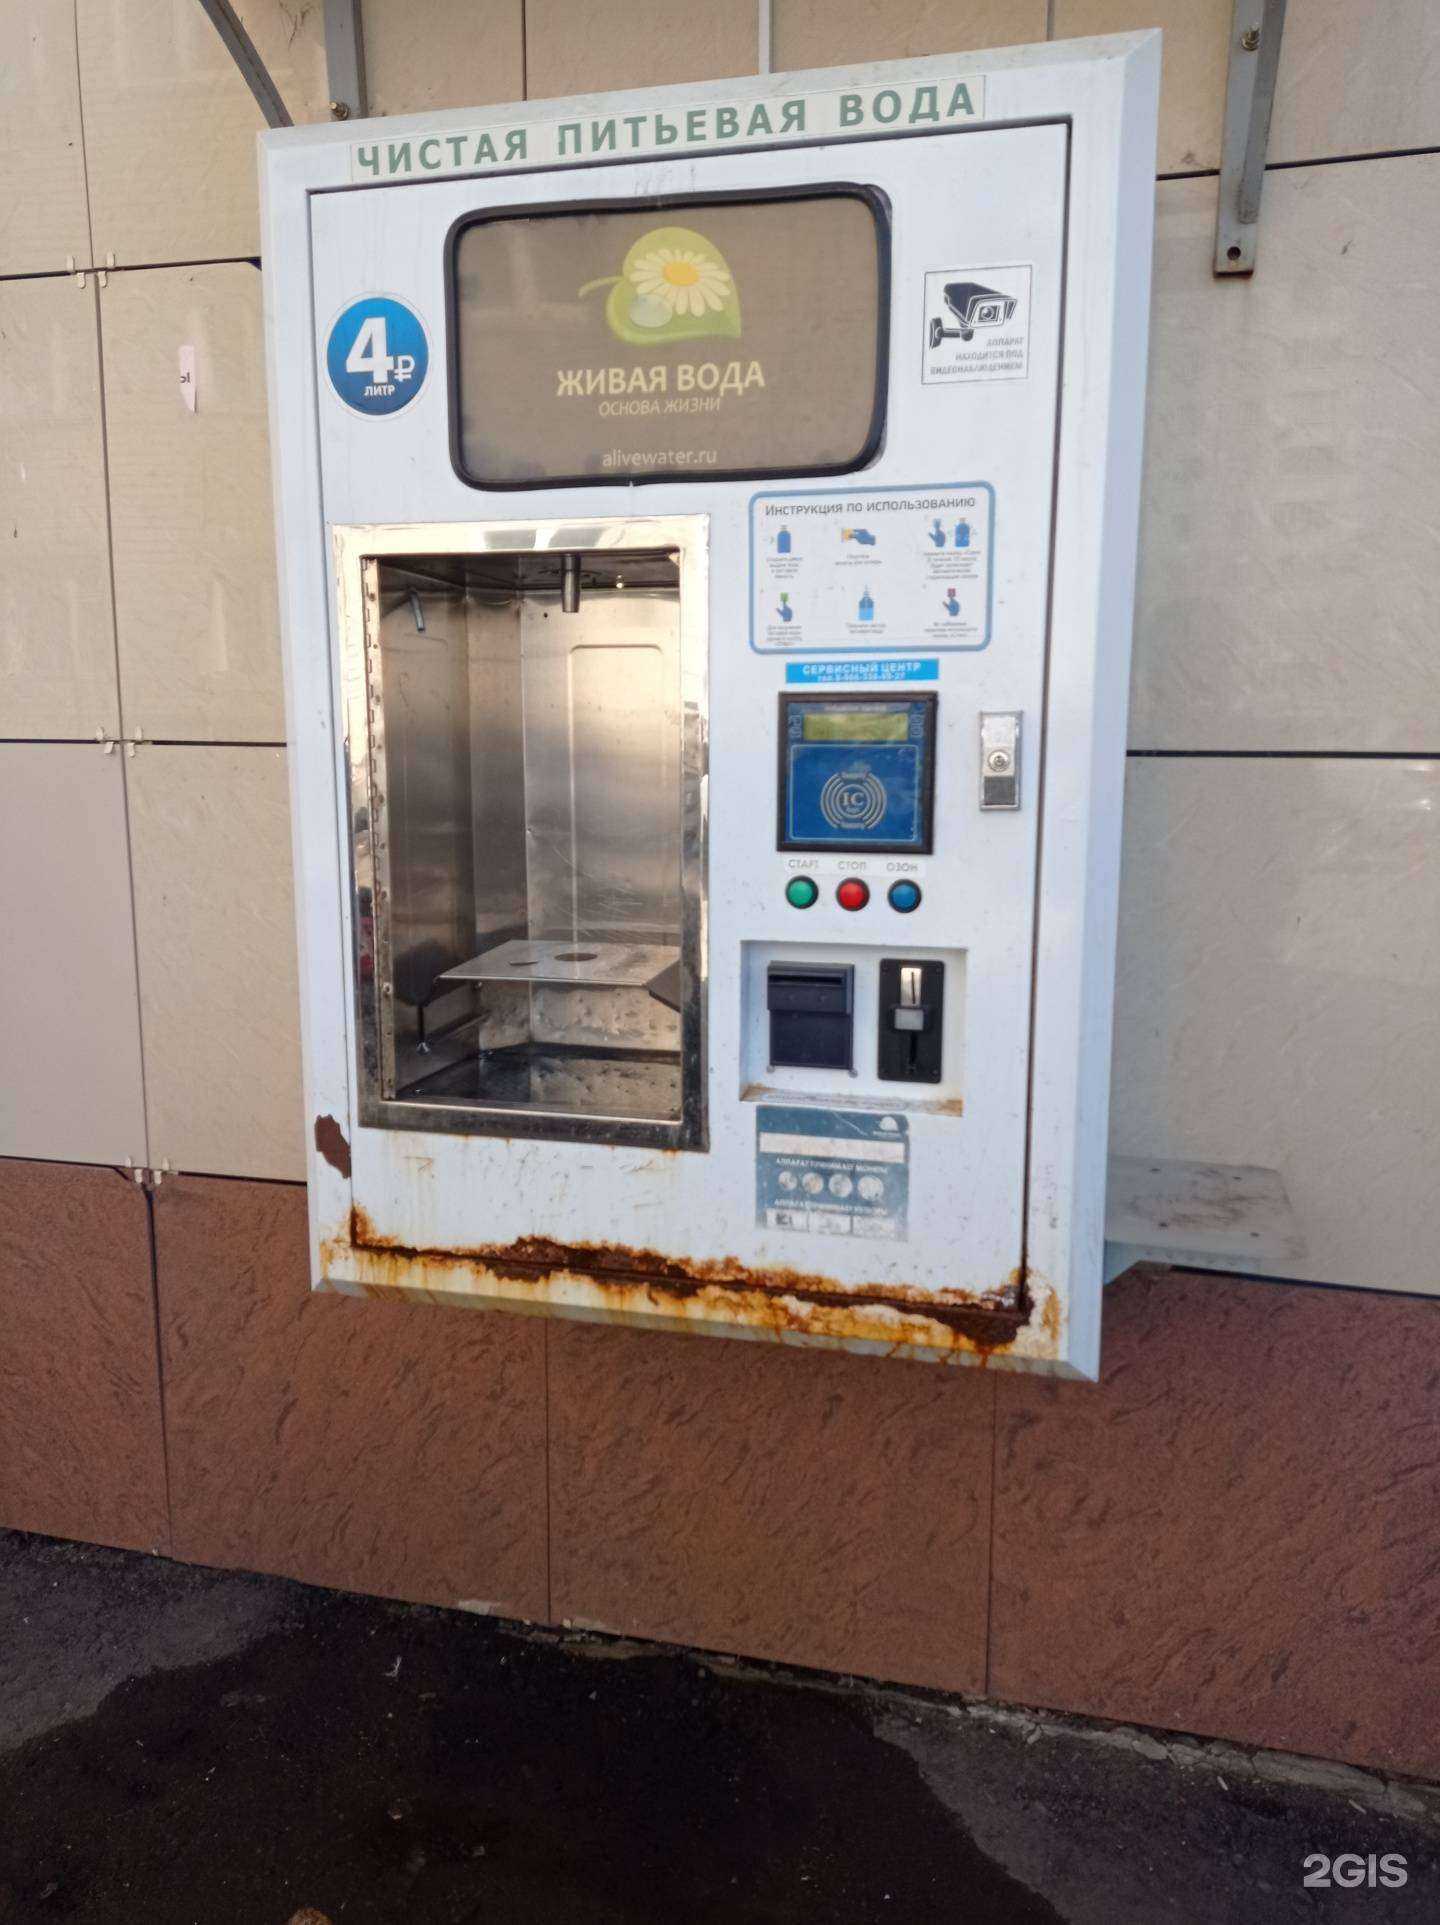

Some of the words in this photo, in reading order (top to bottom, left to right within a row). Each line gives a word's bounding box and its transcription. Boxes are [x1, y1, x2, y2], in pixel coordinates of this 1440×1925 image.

[356, 128, 528, 176] ЧИСТАЯ
[557, 99, 806, 155] ПИТЬЕВАЯ
[838, 82, 975, 127] ВОДА
[556, 365, 668, 396] ЖИВАЯ
[677, 360, 766, 396] ВОДА
[364, 384, 396, 396] ЛИТР
[598, 400, 661, 417] ОСНОВА
[663, 397, 721, 414] ЖИЗНИ
[602, 449, 718, 467] alivewater.ru
[802, 662, 879, 675] СЕРВИСНЫЙ
[881, 661, 921, 673] ЦЕНТР
[838, 861, 867, 871] СТОП
